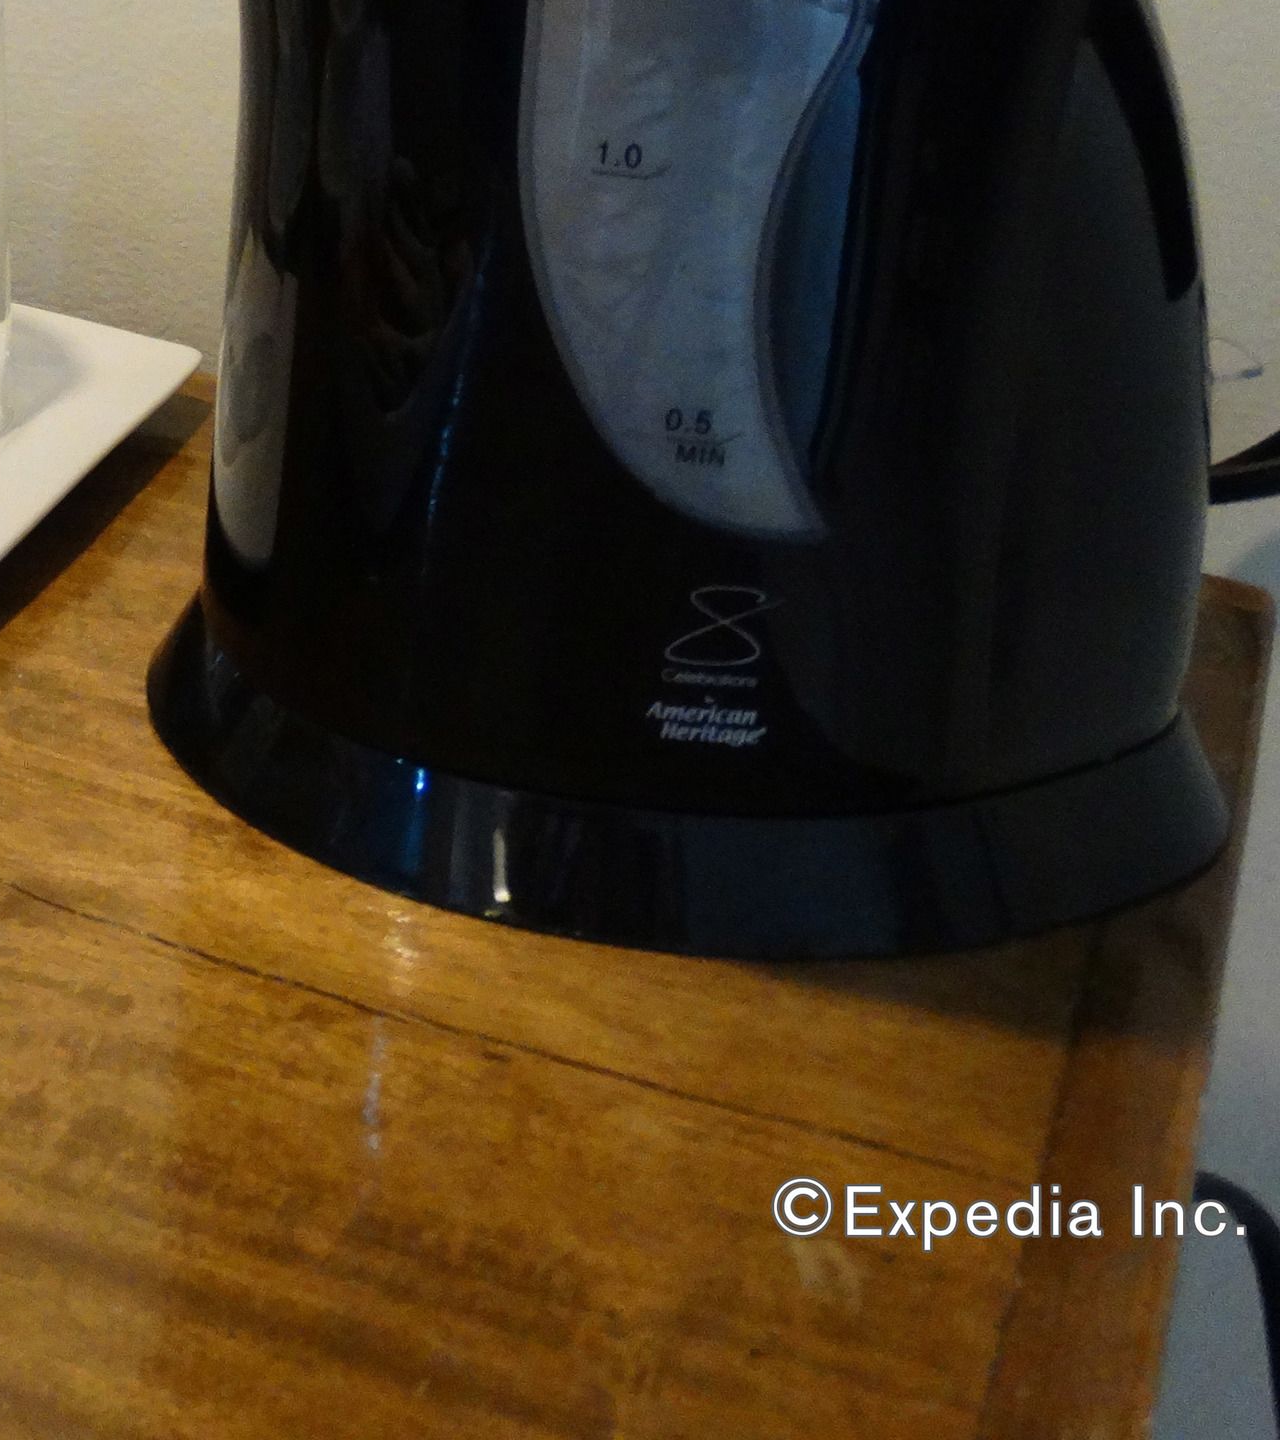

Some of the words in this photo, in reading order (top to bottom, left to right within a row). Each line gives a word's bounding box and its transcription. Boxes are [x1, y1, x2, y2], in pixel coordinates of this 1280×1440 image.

[597, 140, 643, 169] 1.0
[664, 407, 712, 435] 0.5
[675, 444, 726, 467] MIN
[645, 699, 760, 727] American
[659, 721, 769, 748] Heritage
